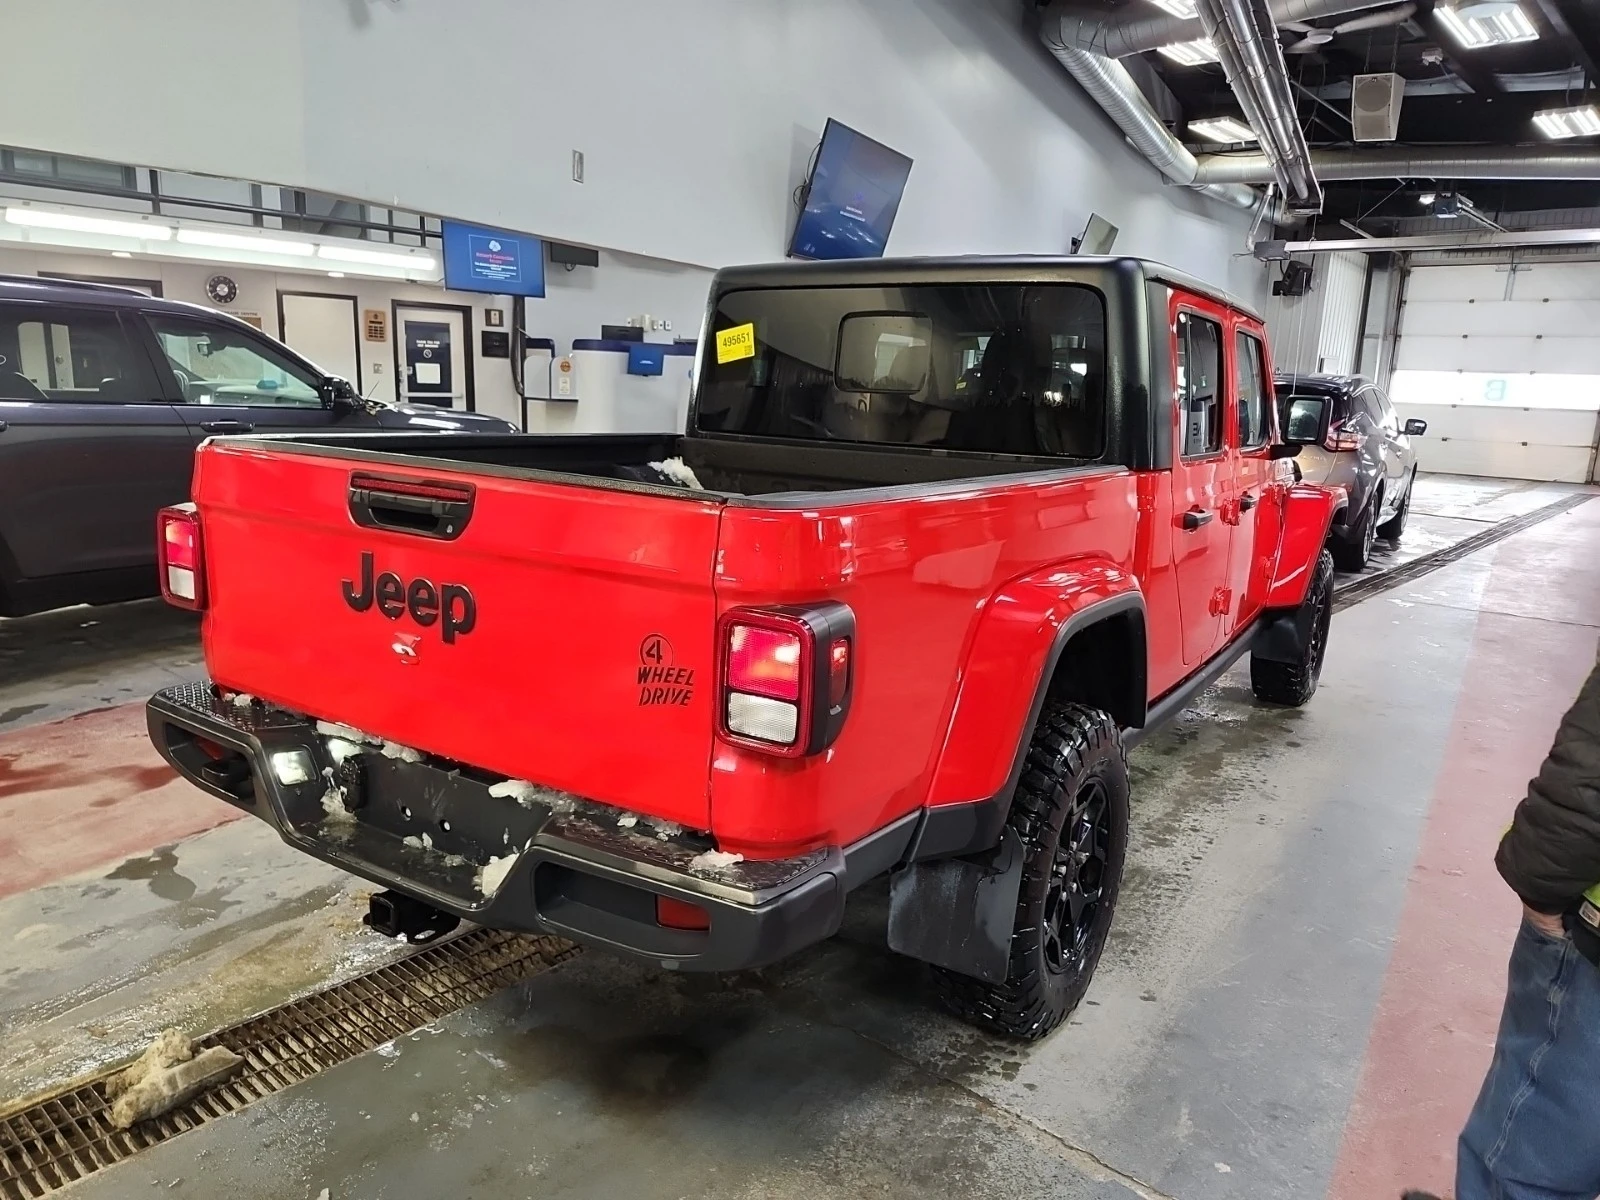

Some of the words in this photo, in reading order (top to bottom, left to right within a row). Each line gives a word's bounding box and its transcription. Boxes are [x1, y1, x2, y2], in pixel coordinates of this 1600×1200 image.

[722, 332, 751, 348] 495651
[341, 551, 476, 645] Jeep
[645, 639, 663, 665] 4
[637, 666, 695, 687] WHEEL
[639, 686, 694, 707] DRIVE
